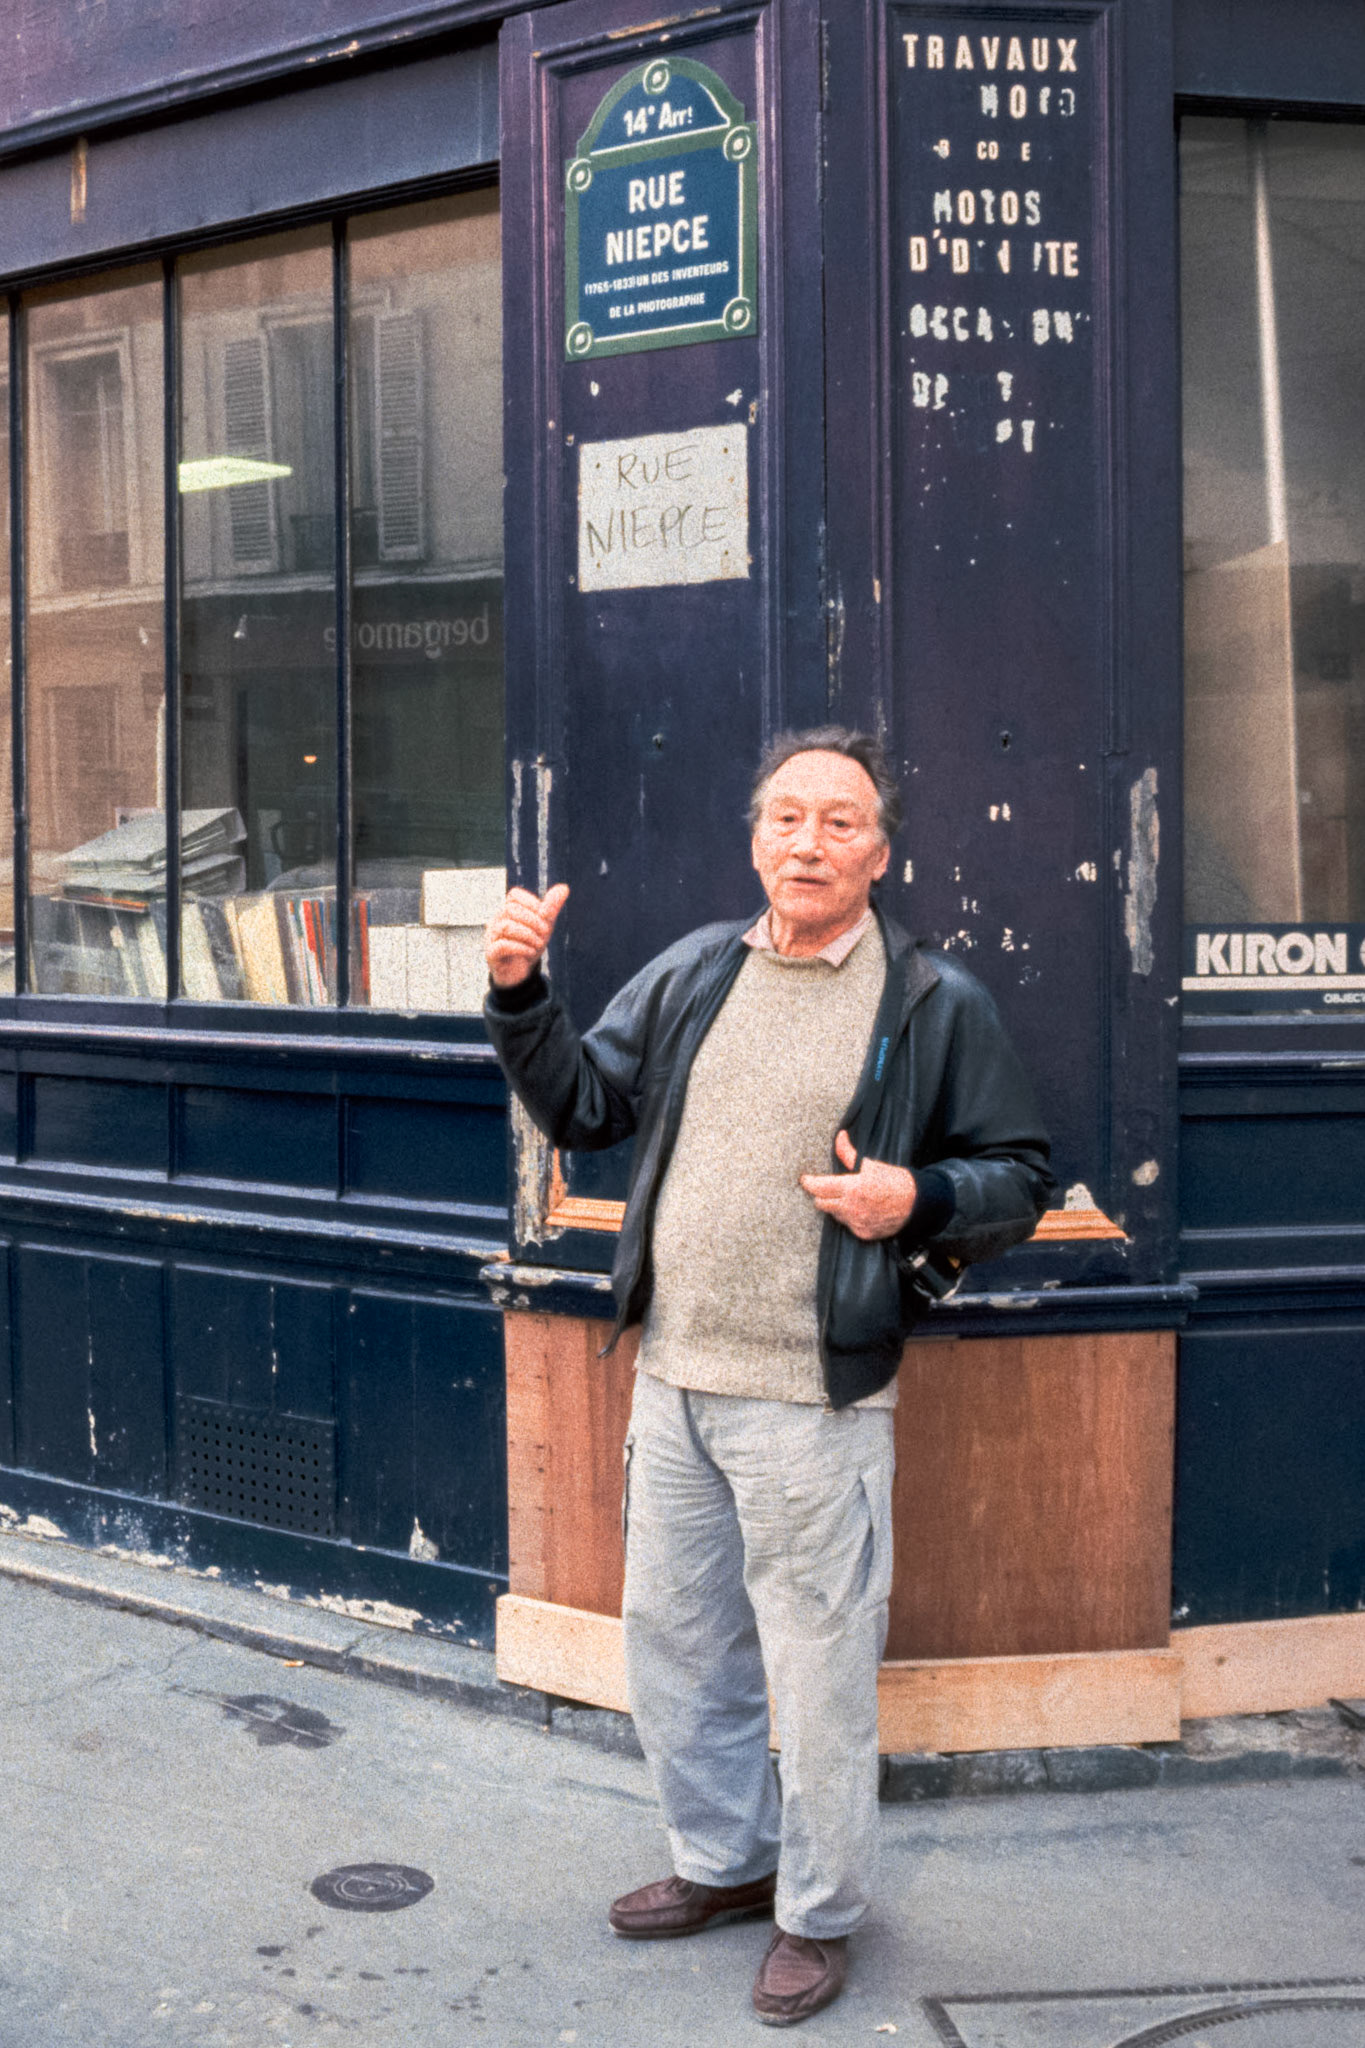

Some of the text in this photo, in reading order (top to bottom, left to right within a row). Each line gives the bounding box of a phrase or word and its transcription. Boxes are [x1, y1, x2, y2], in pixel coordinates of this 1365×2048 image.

[903, 33, 1078, 72] TRAVAUX
[629, 170, 686, 214] RUE
[606, 214, 709, 266] NIEPCE
[636, 274, 650, 287] UN
[651, 270, 670, 285] DES
[672, 260, 730, 281] INVENTEURS
[609, 292, 706, 319] DE LA PHOTOGRAPHIE
[618, 444, 699, 490] RUE
[586, 504, 728, 558] NIEPCE
[1196, 932, 1348, 975] KIRON
